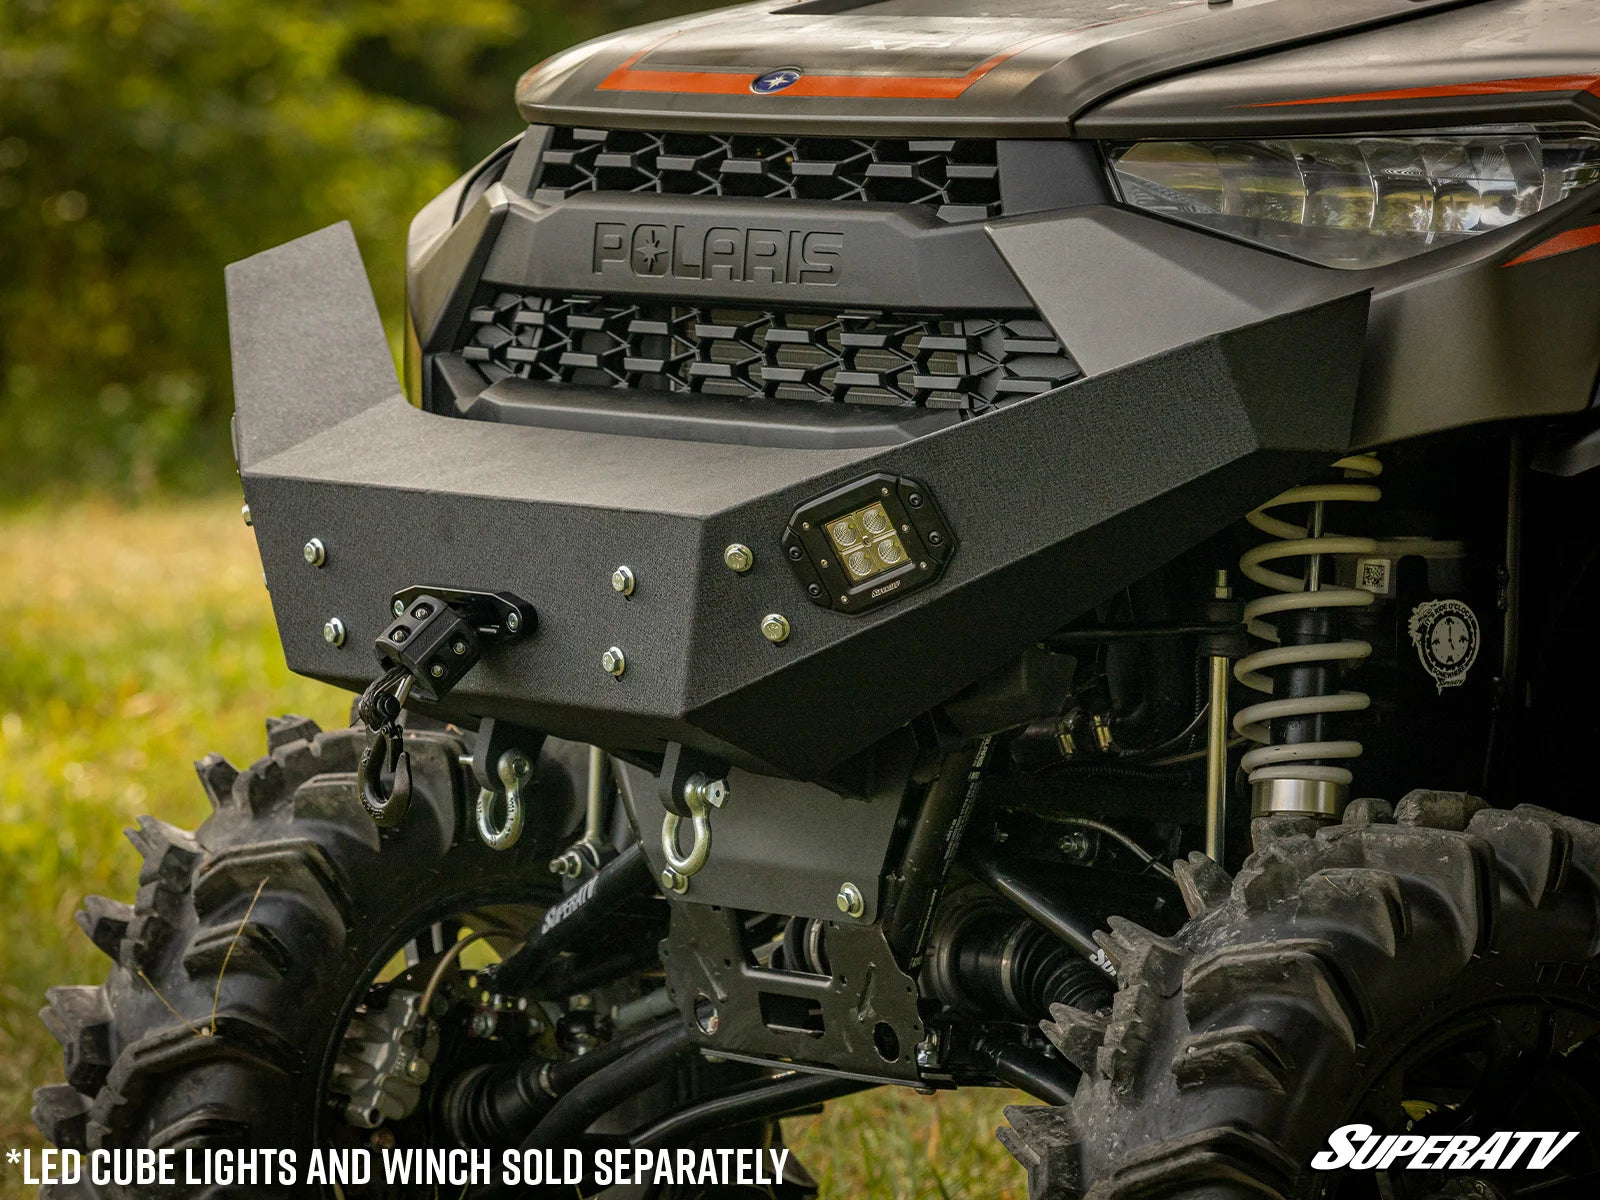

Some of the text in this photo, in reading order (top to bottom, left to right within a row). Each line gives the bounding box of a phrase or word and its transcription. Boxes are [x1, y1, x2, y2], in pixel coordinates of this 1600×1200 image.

[592, 221, 844, 287] POLARIS
[1434, 603, 1448, 615] RIDE
[1448, 602, 1474, 621] O'CLOCK
[1432, 664, 1467, 679] SOMEWHERE
